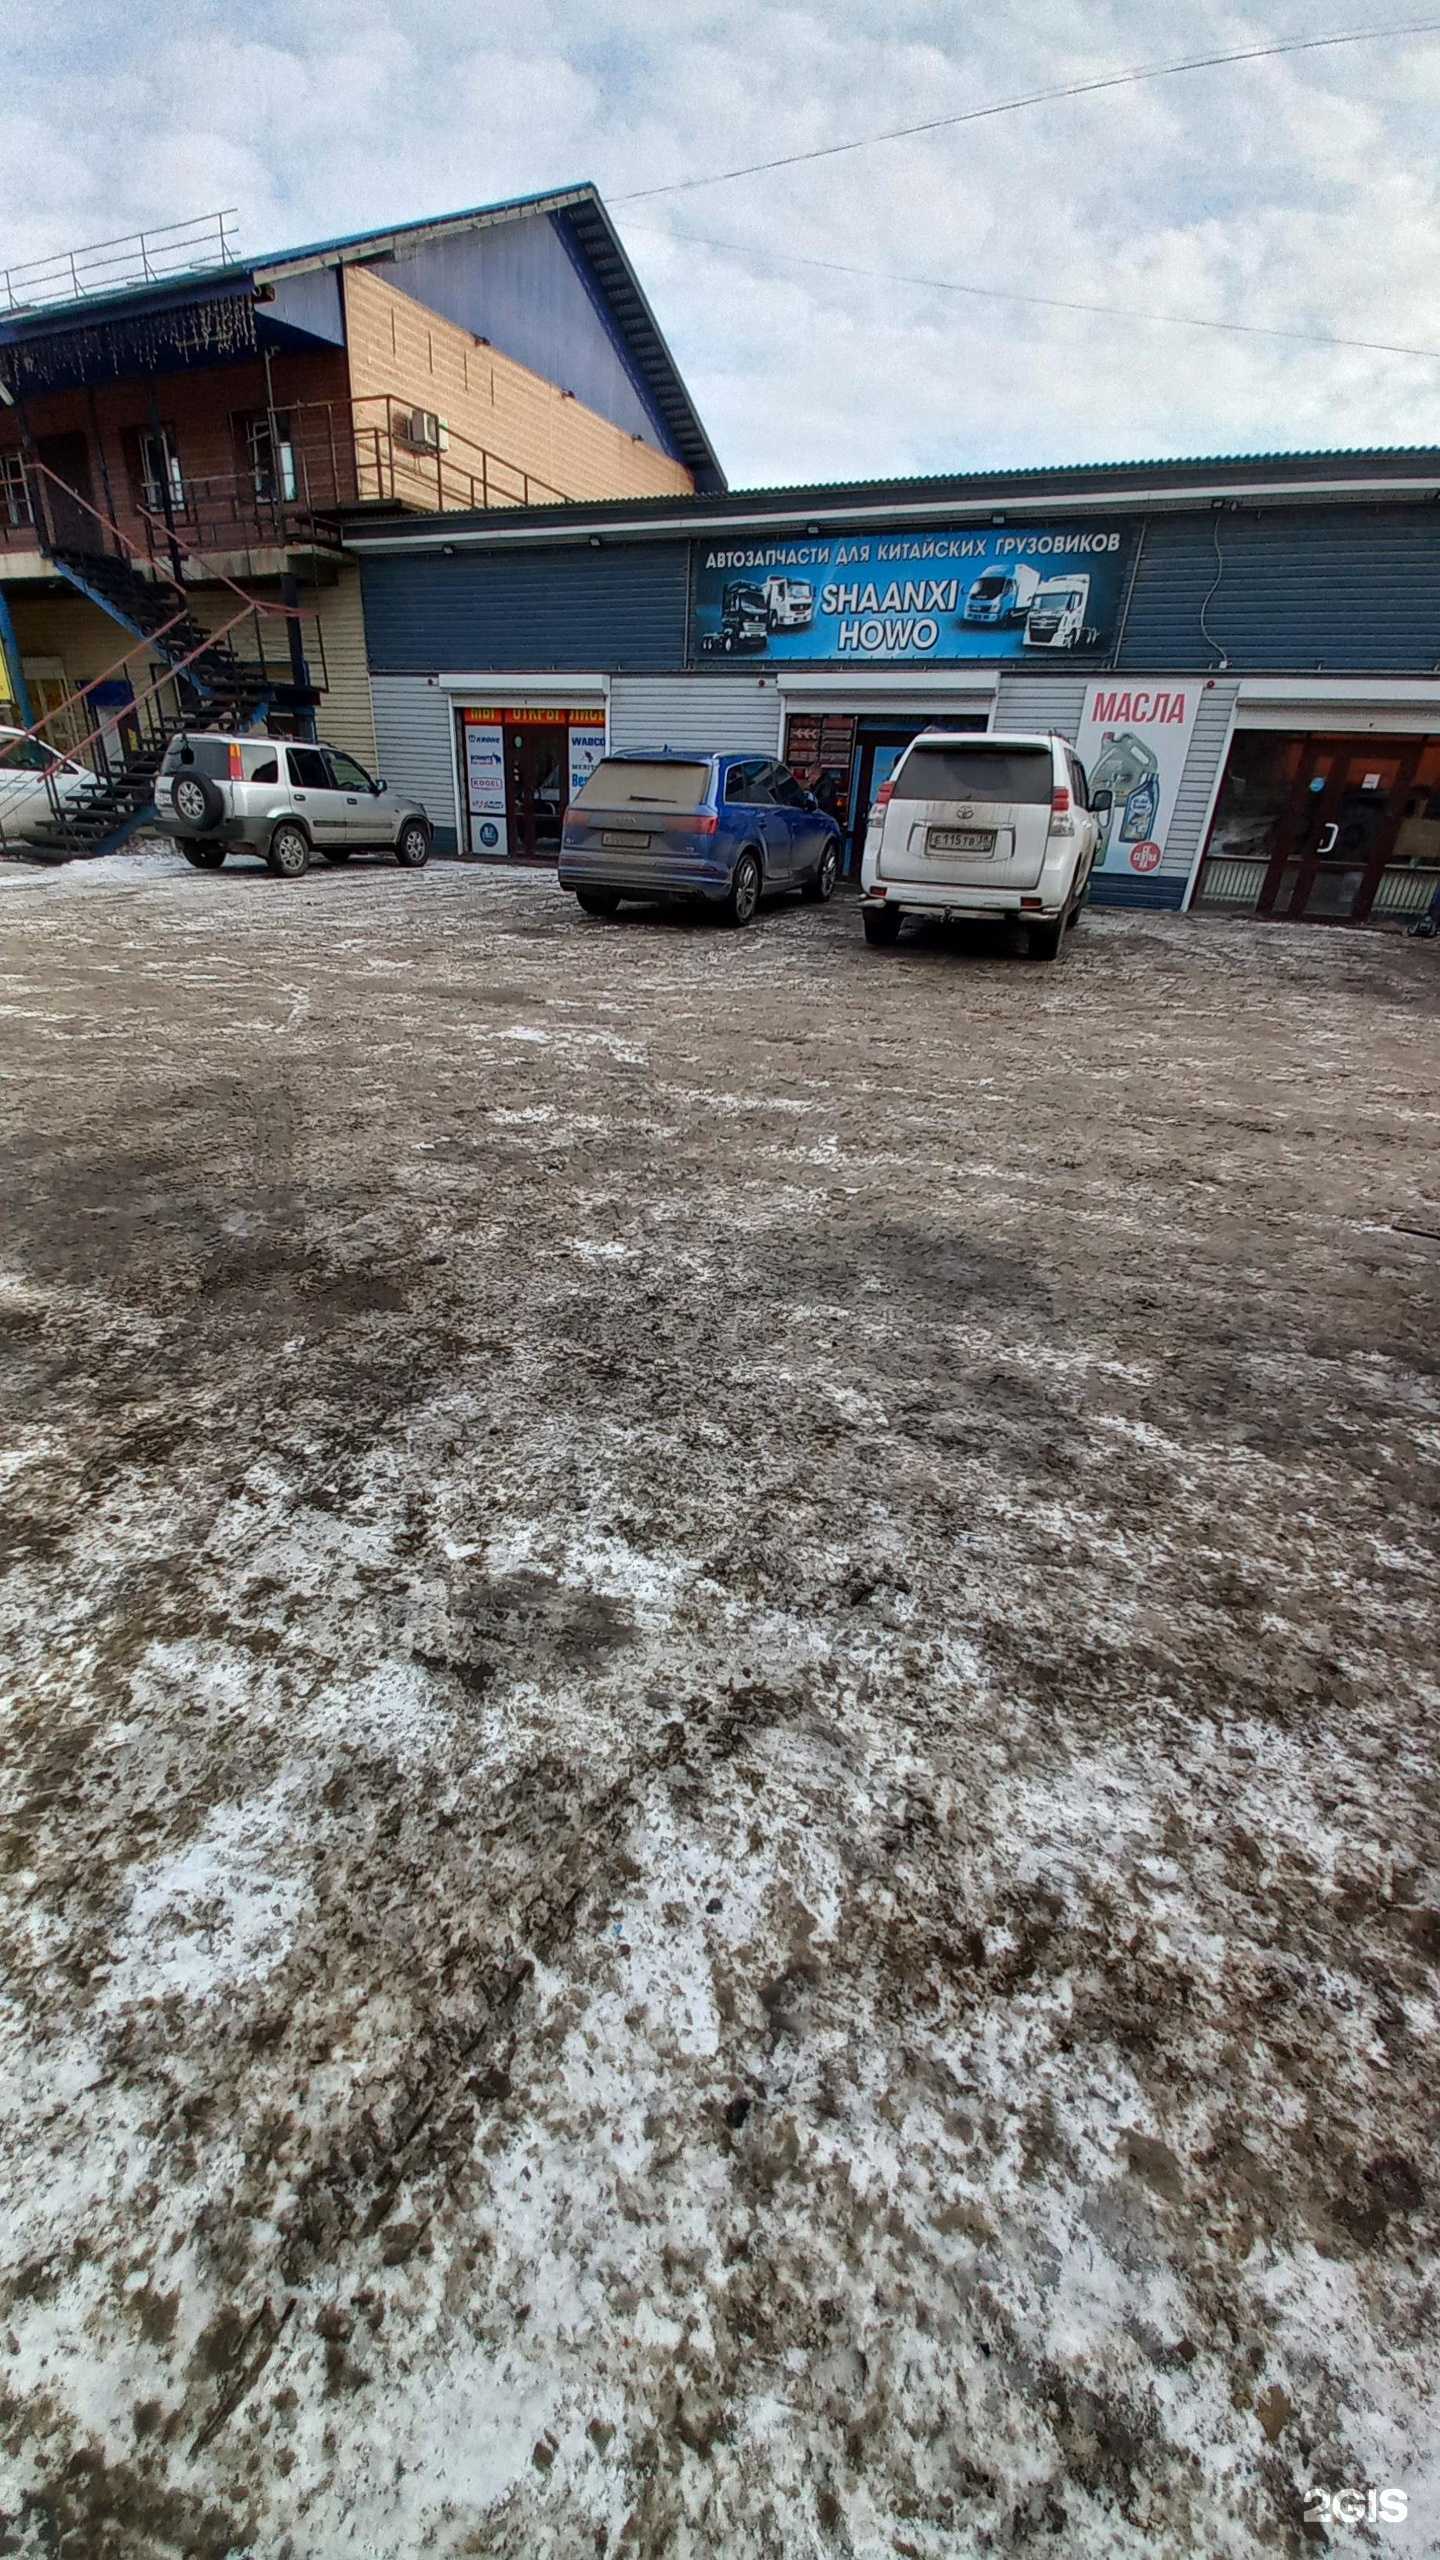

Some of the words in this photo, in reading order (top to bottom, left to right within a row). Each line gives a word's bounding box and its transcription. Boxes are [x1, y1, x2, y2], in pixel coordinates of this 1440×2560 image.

[705, 547, 829, 569] АВТОЗАПЧАСТИ
[835, 545, 870, 566] ДЛЯ
[877, 537, 987, 562] КИТАЙСКИХ
[995, 532, 1120, 556] ГРУЗОВИКОВ
[821, 579, 958, 615] SHAANXI
[837, 618, 939, 651] HOWO
[1092, 692, 1185, 724] МАСЛА
[572, 737, 605, 746] WABCO
